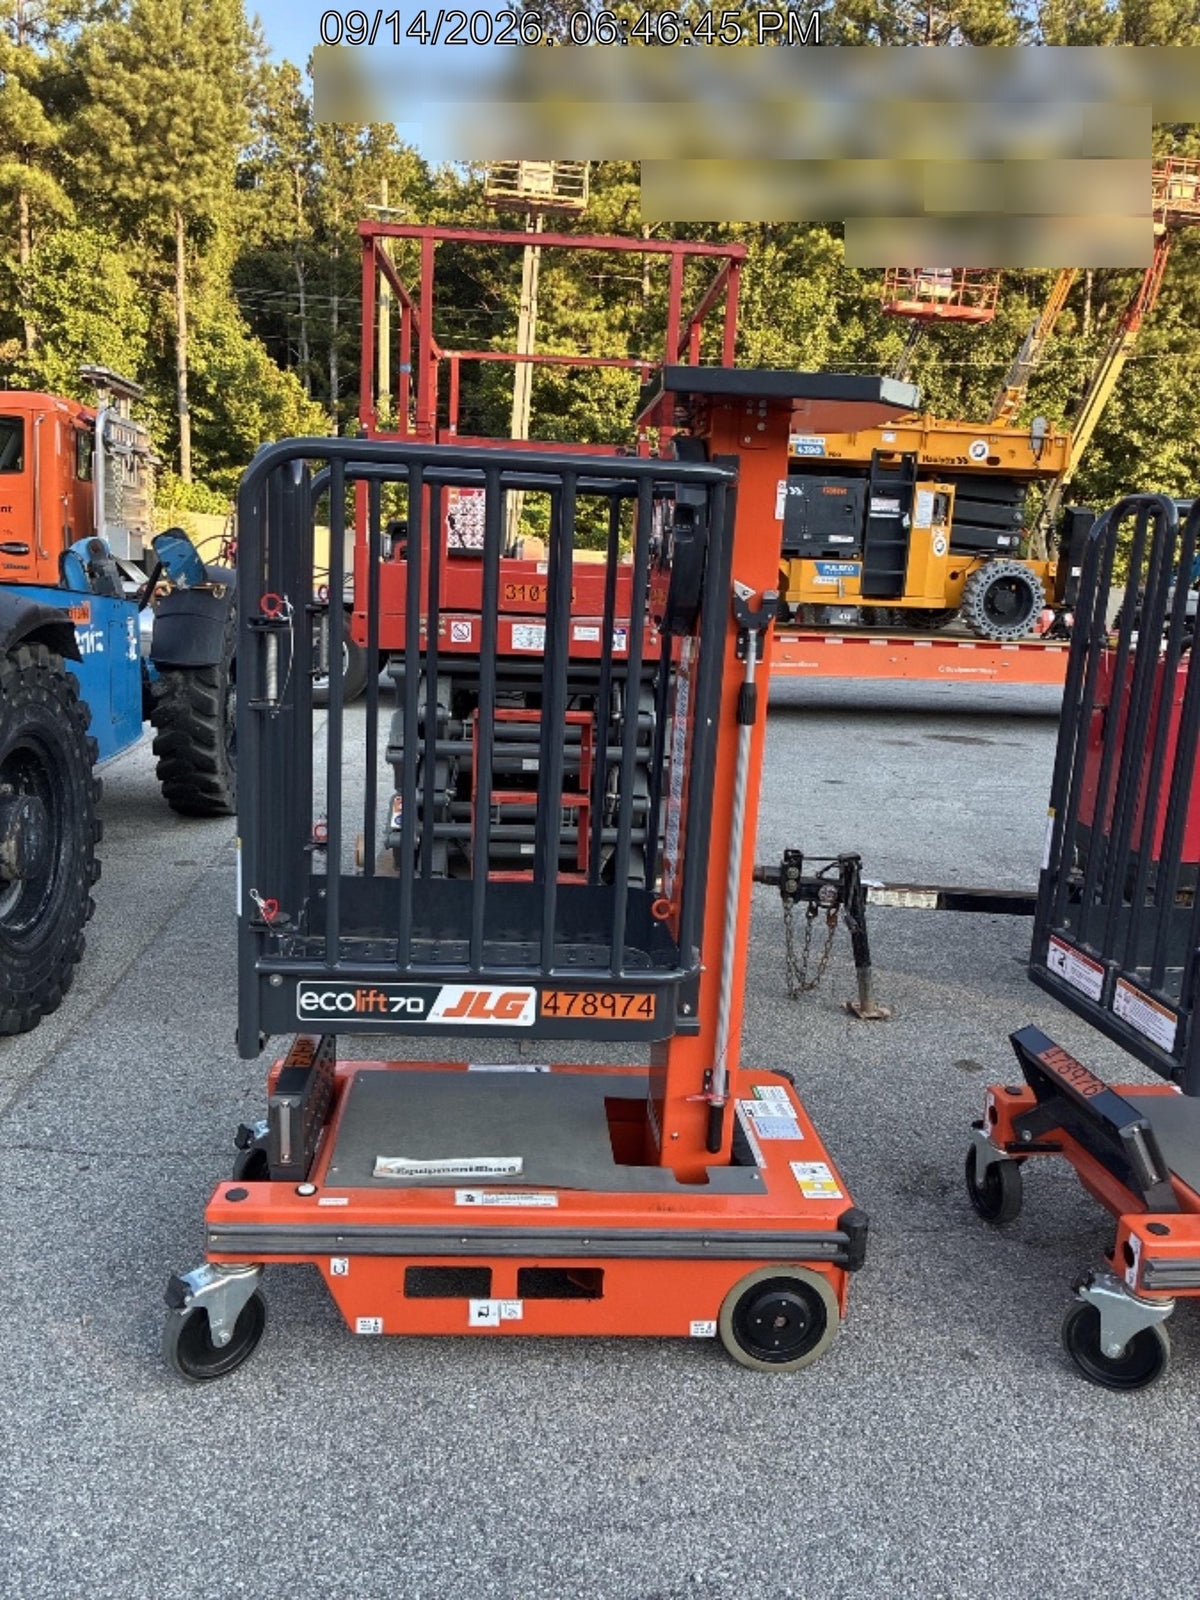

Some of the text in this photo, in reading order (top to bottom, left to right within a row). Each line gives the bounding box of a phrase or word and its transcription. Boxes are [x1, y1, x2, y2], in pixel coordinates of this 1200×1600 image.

[442, 991, 529, 1019] JLG
[543, 993, 654, 1018] 478974
[1043, 1048, 1106, 1096] 478976
